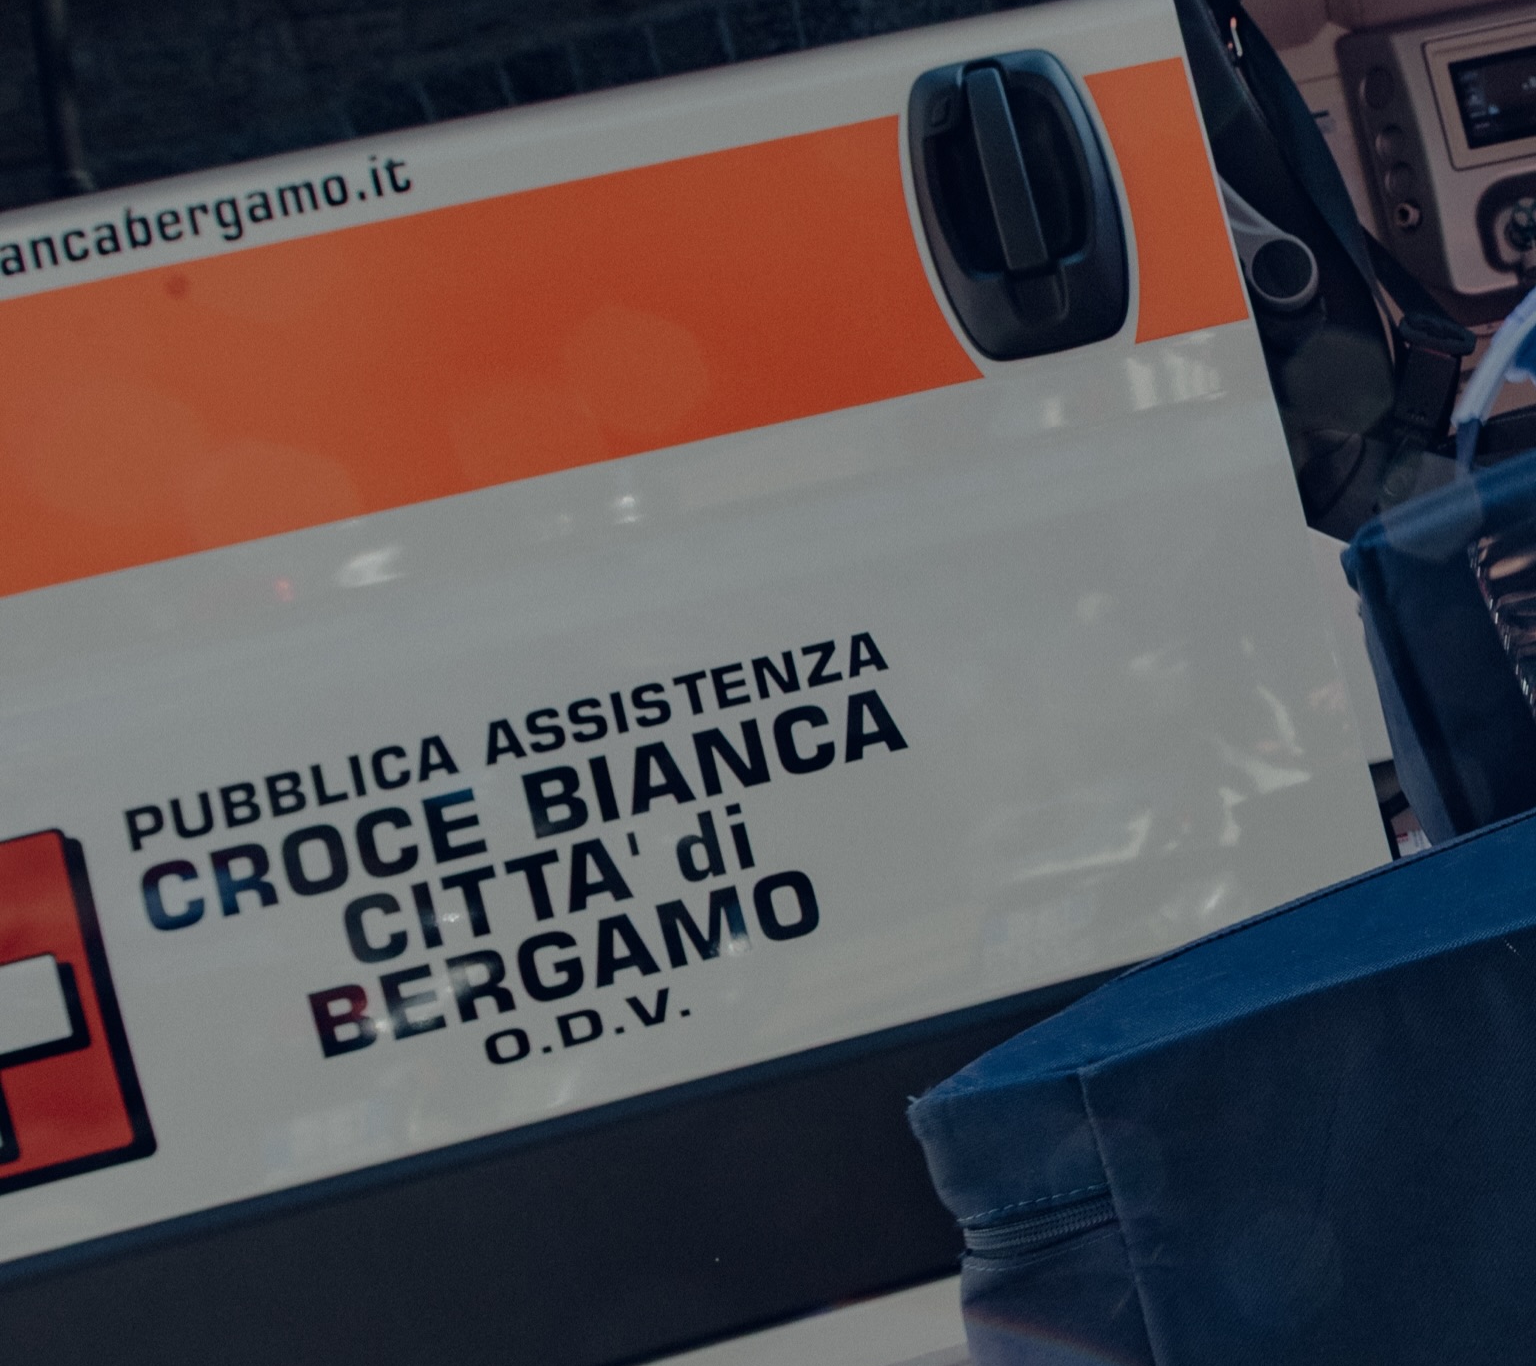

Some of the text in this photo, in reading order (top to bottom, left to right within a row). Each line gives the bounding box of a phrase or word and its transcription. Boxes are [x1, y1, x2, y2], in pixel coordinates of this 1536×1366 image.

[0, 155, 412, 277] ancabergamo.it
[123, 630, 891, 853] PUBBLICA ASSISTENZA
[139, 688, 910, 933] CROCE BIANCA
[676, 801, 757, 884] di
[306, 868, 821, 1060] BERGAMO
[483, 986, 693, 1067] O.D.V.
